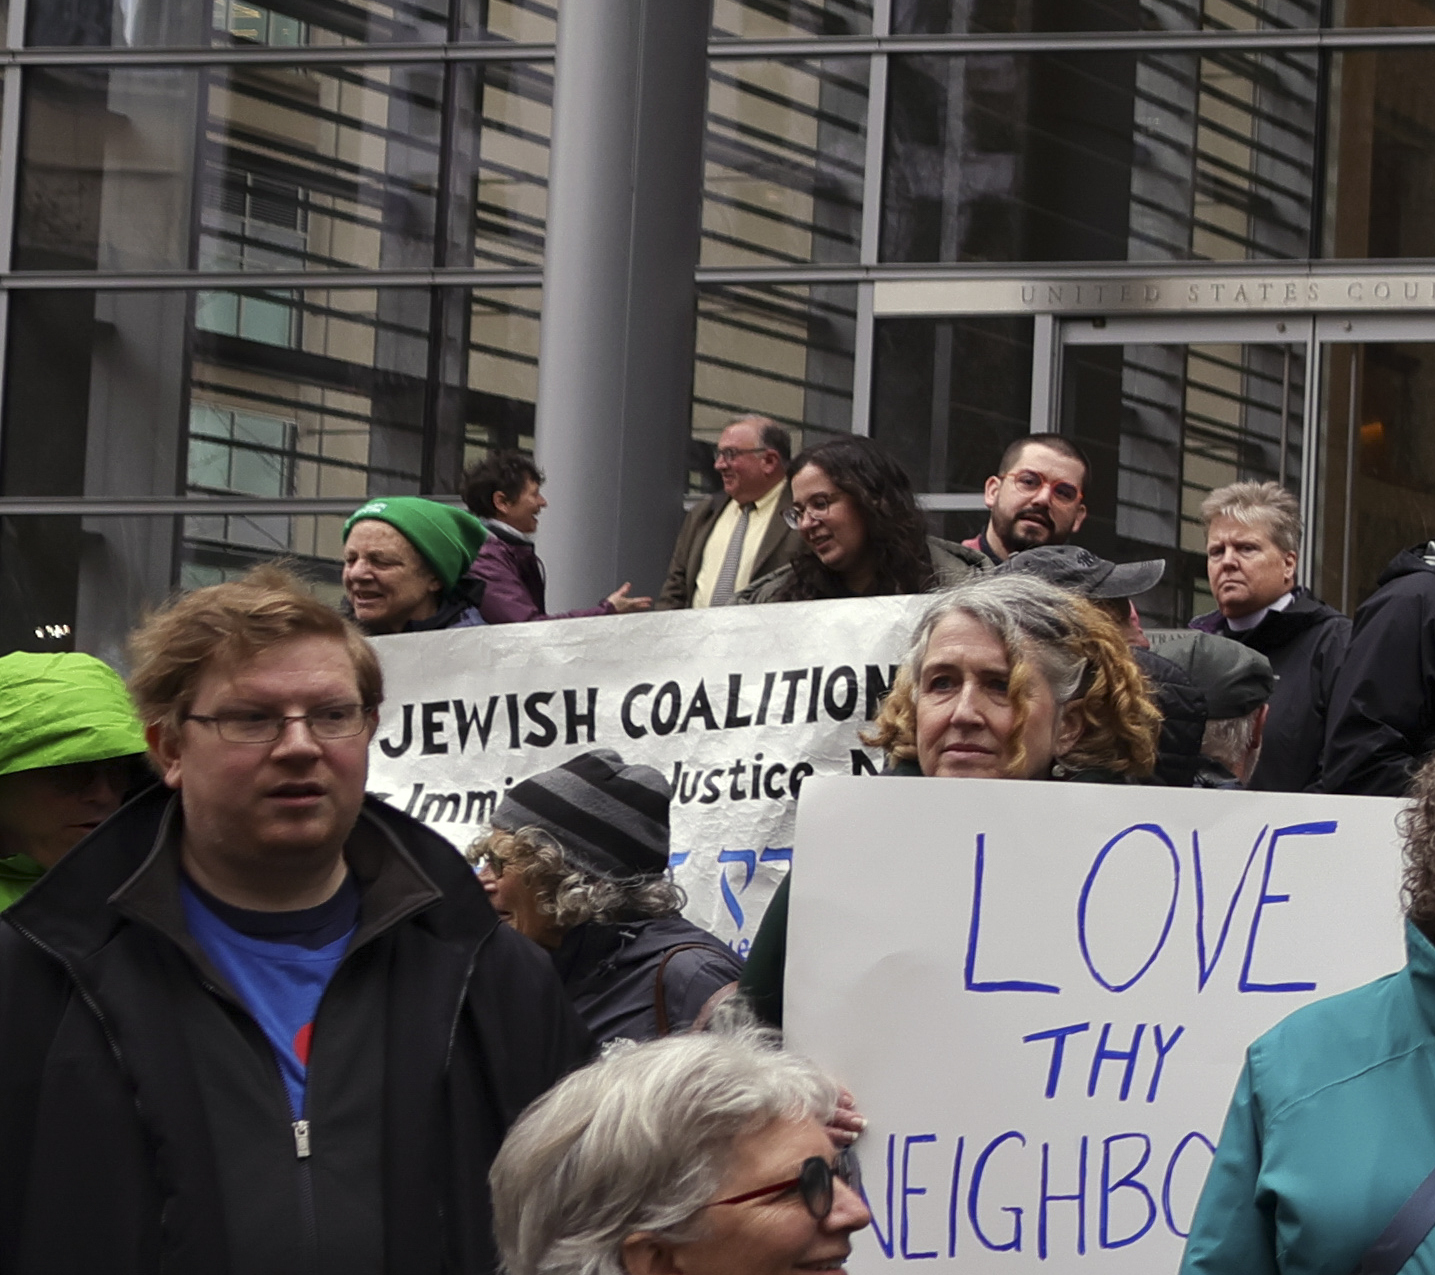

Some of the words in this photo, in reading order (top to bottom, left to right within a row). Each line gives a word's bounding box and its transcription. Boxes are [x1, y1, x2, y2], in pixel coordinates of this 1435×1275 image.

[1021, 284, 1160, 304] UNITED
[1187, 282, 1319, 303] STATES
[379, 687, 601, 759] JEWISH
[620, 663, 899, 740] COALITION
[964, 820, 1338, 994] LOVE
[1023, 1021, 1185, 1103] THY
